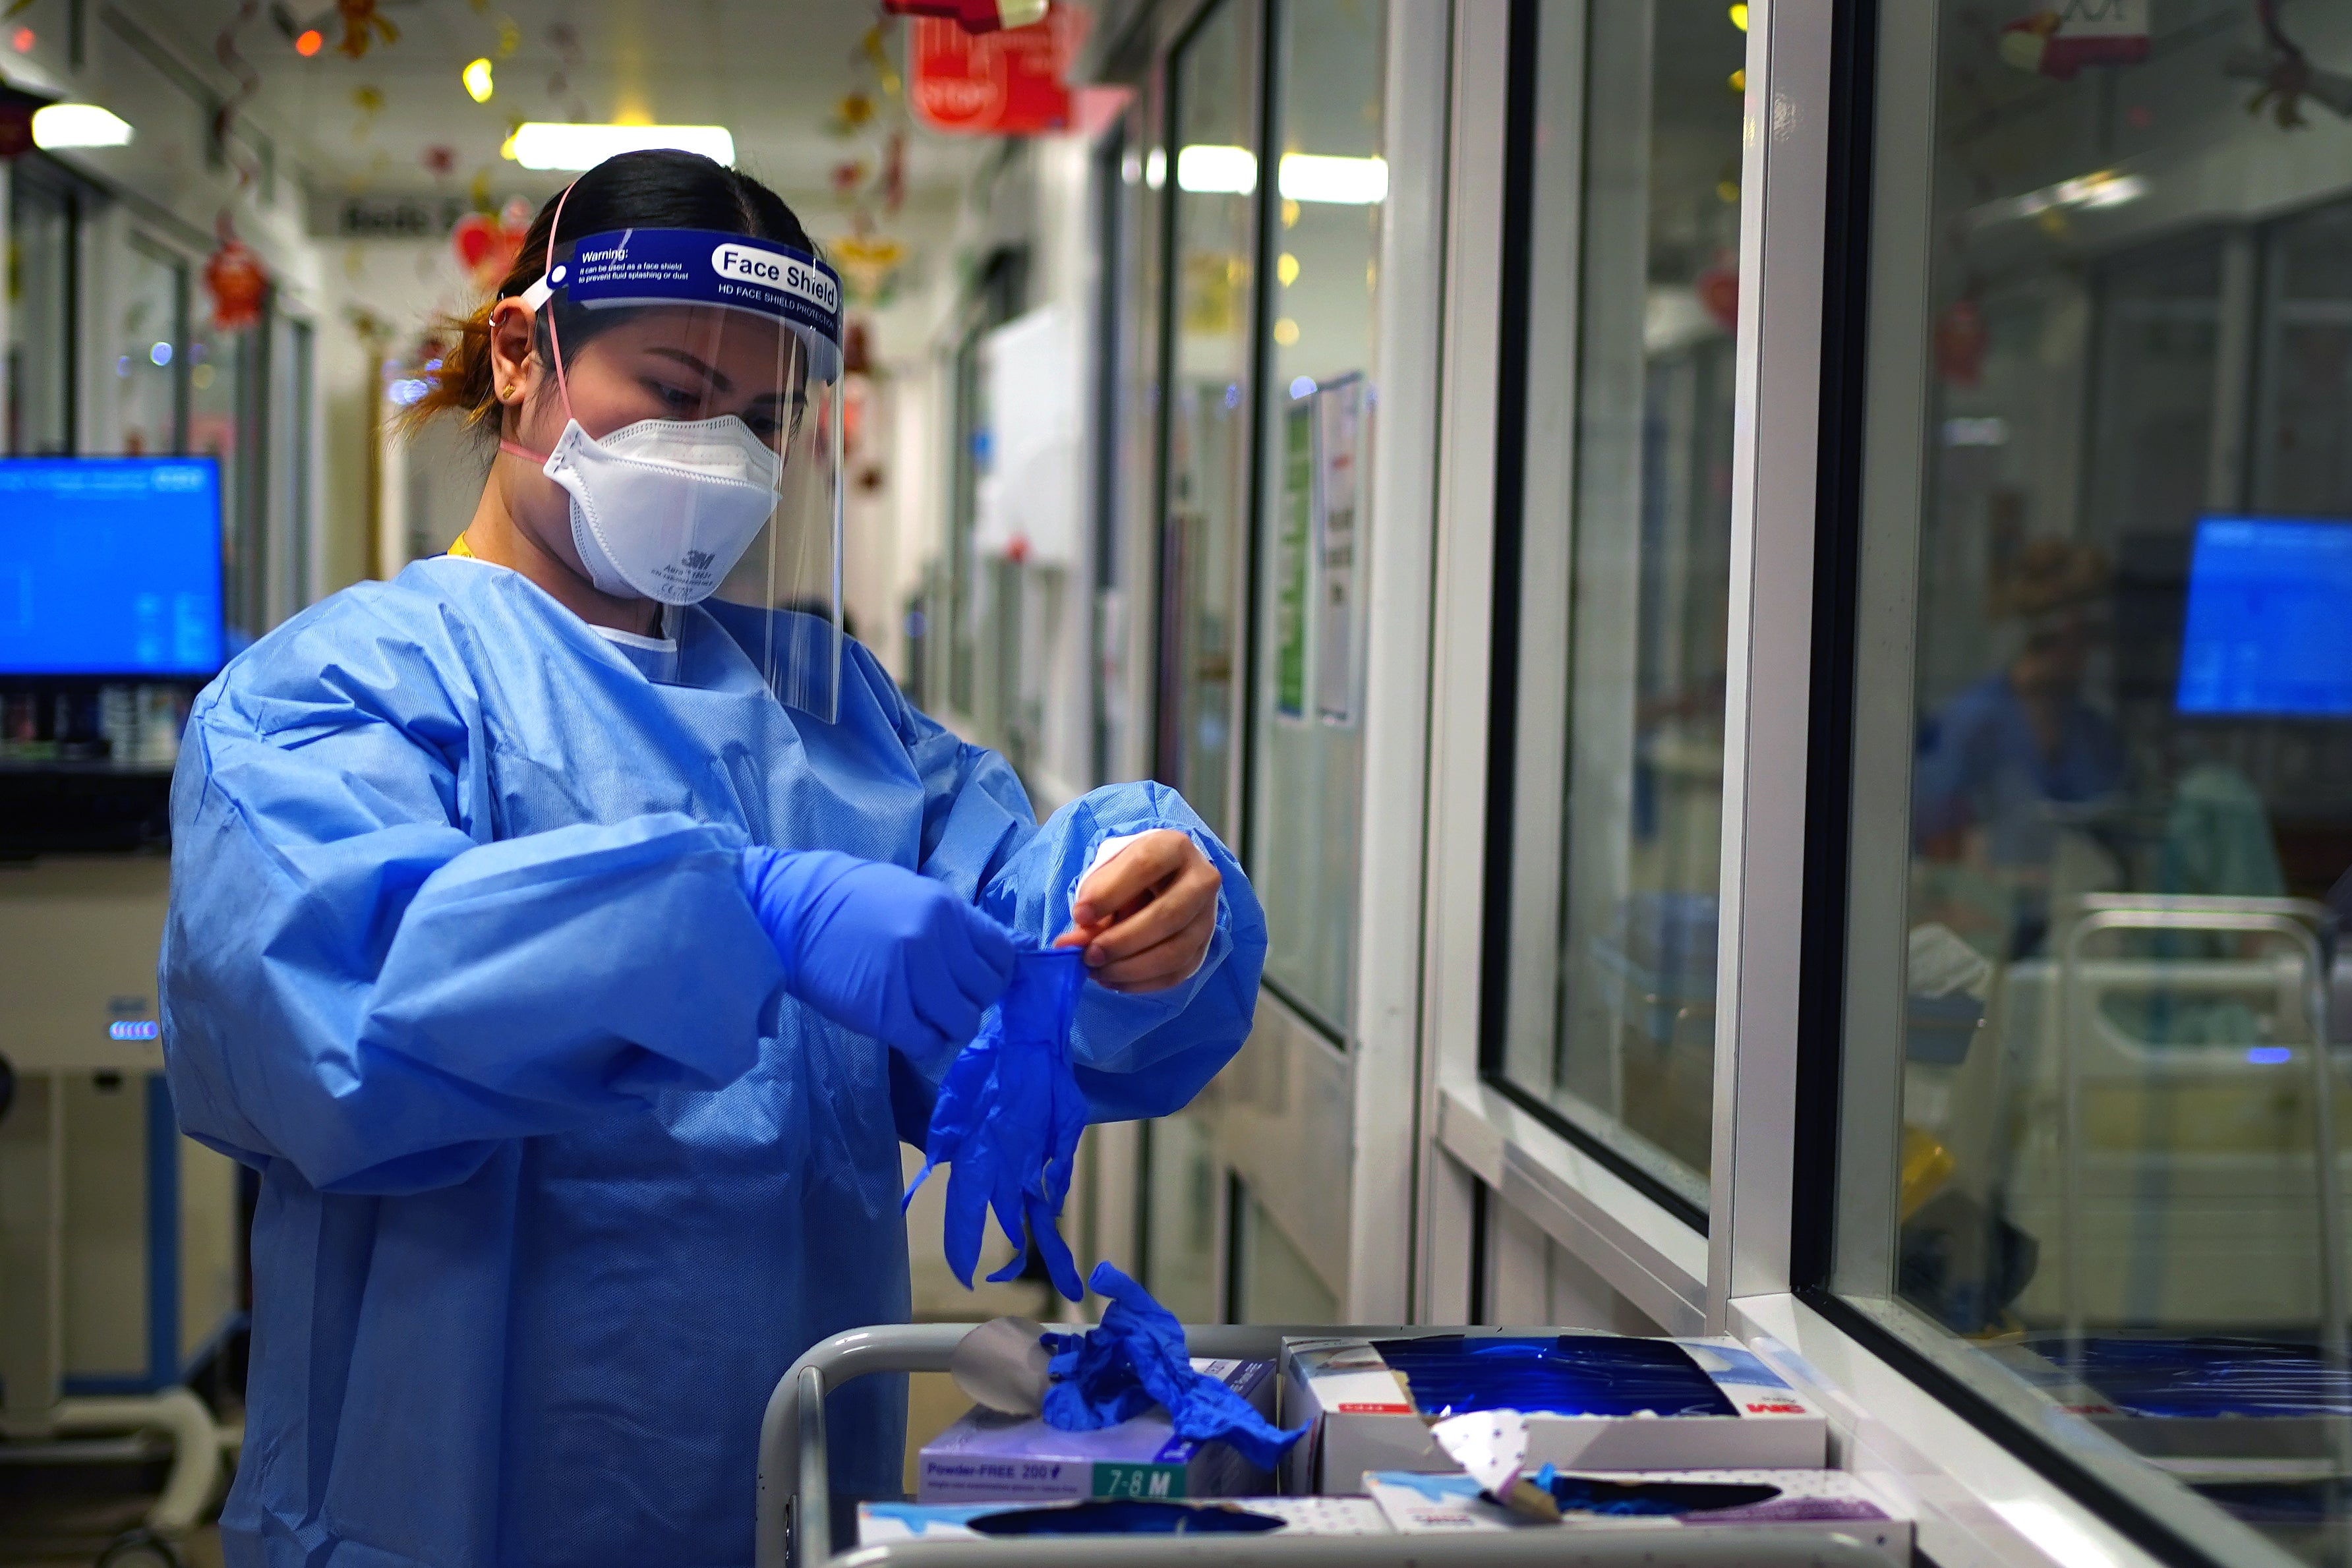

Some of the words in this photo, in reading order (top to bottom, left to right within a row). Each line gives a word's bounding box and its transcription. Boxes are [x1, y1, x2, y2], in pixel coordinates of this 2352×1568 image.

[582, 247, 629, 264] Warning:
[585, 266, 597, 275] can
[608, 263, 626, 272] used
[643, 262, 659, 271] face
[661, 262, 682, 271] shield
[585, 272, 611, 284] prevent
[612, 272, 627, 280] fluid
[628, 271, 662, 281] splashing
[723, 250, 780, 281] Face
[787, 266, 835, 308] Shield
[719, 283, 734, 295] HD
[736, 286, 762, 301] FACE
[764, 293, 795, 310] SHIELD
[796, 303, 835, 331] PROTECTION
[682, 550, 716, 571] 3M
[1022, 1464, 1047, 1480] 200
[1108, 1469, 1144, 1497] 7-8
[1148, 1470, 1172, 1498] M
